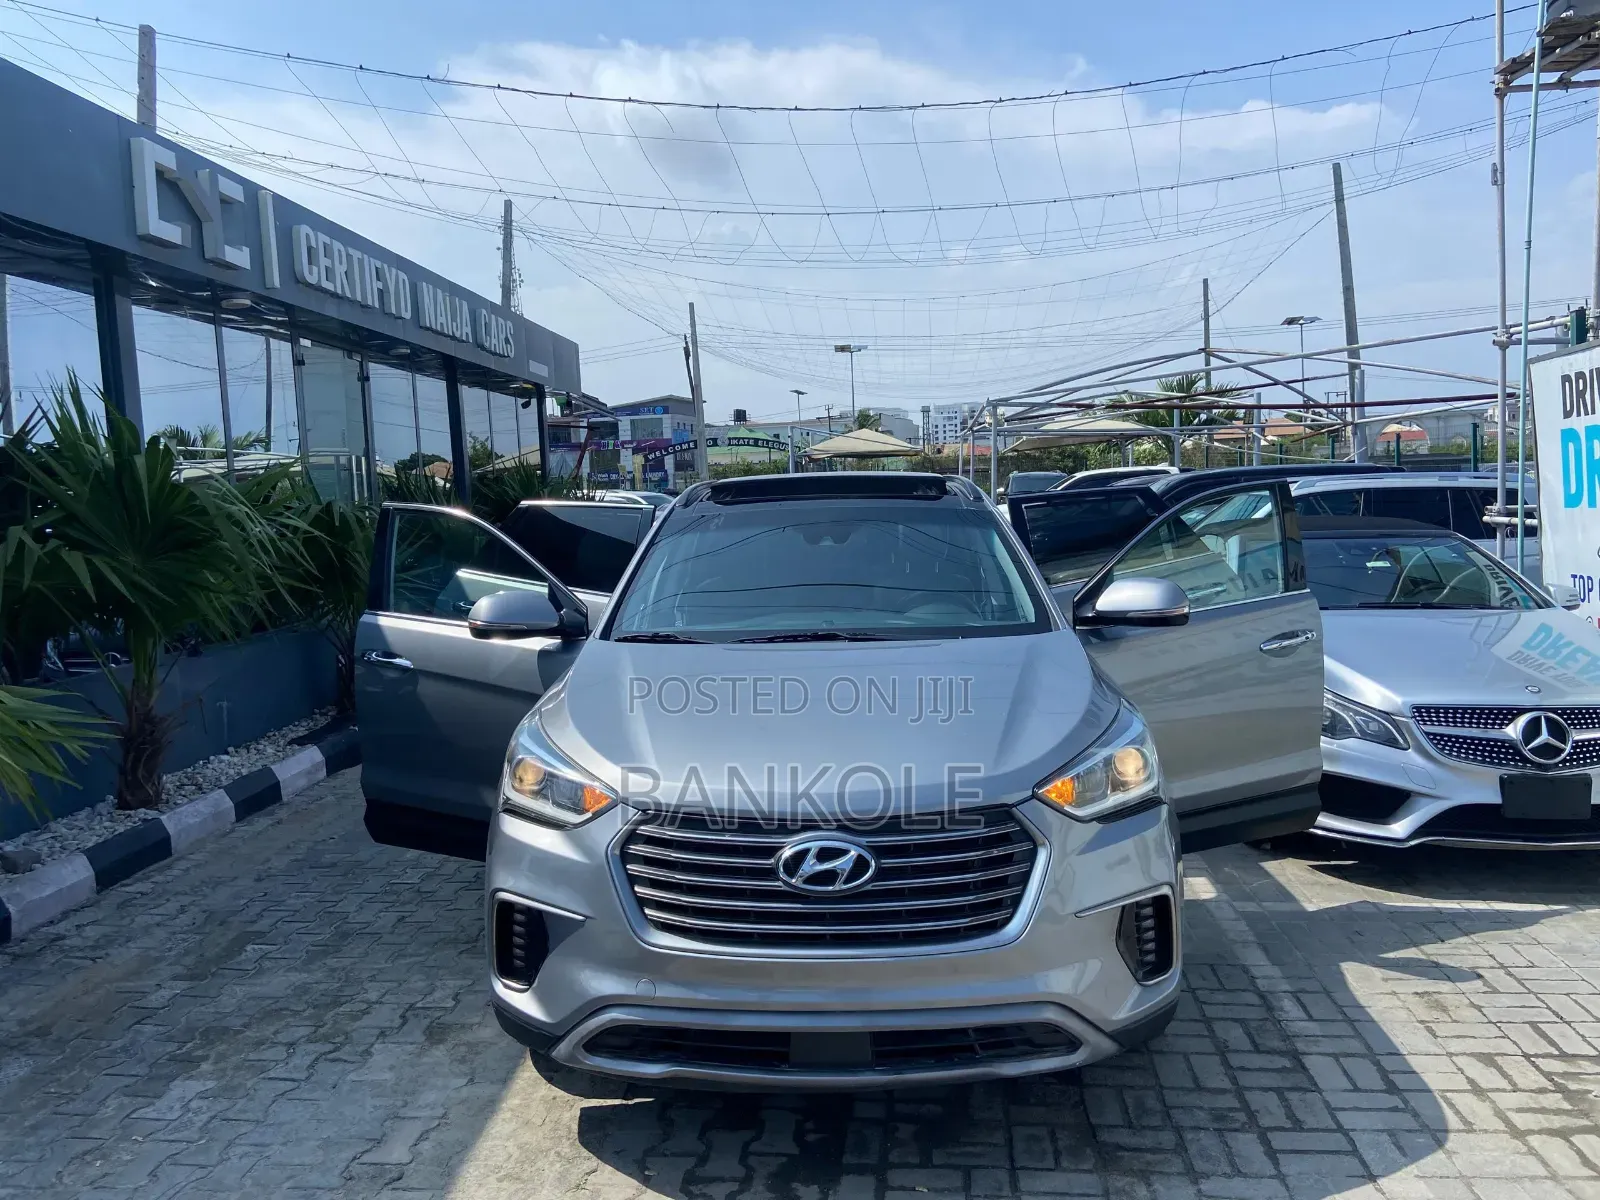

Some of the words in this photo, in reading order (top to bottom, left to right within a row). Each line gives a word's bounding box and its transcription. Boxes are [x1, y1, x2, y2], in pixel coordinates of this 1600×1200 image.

[293, 224, 412, 320] CERTIFYD
[417, 281, 473, 343] NAIJA
[476, 308, 515, 359] CARS
[647, 441, 695, 460] WELCOME
[730, 438, 755, 446] IKATE
[1570, 573, 1594, 603] TOP
